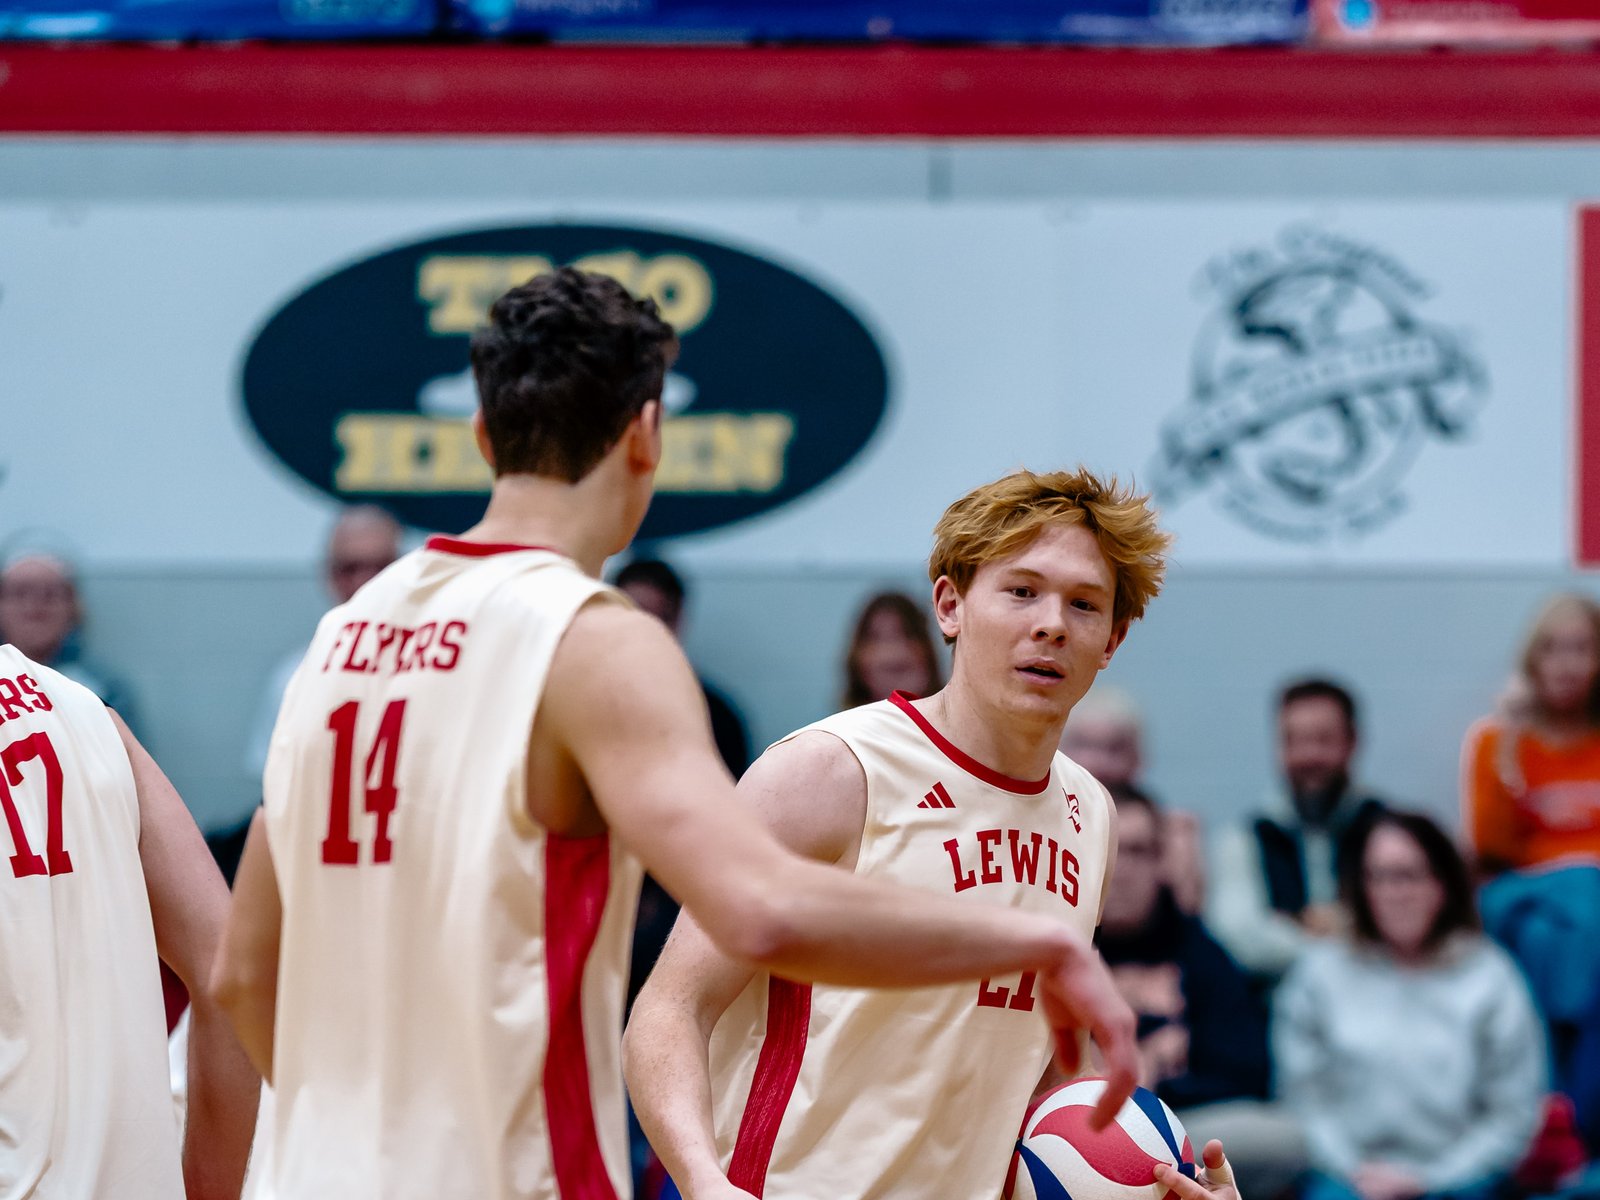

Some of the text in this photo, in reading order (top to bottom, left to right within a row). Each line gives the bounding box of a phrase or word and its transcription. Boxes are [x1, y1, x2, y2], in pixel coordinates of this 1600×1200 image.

[418, 252, 715, 335] TO
[0, 673, 53, 726] RS
[0, 731, 74, 879] 17
[322, 698, 410, 867] 14
[943, 828, 1080, 908] LEWIS
